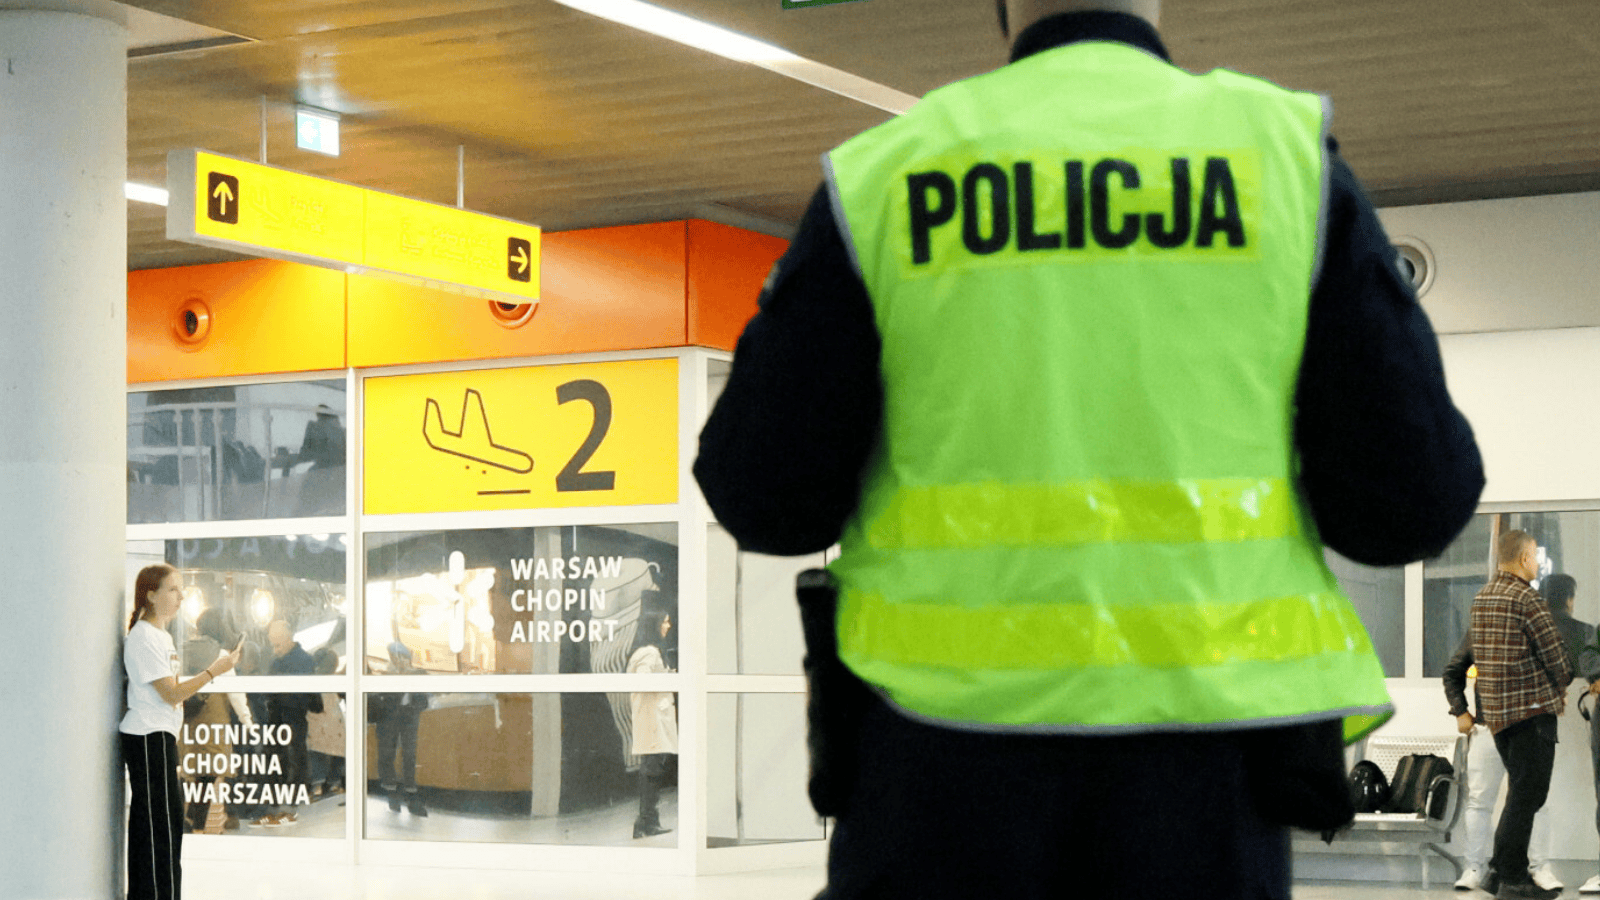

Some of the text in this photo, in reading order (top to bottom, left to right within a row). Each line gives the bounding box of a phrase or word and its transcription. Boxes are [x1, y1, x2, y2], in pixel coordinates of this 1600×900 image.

[907, 157, 1247, 265] POLICJA
[555, 379, 616, 492] 2
[510, 555, 623, 581] WARSAW
[510, 588, 606, 612] CHOPIN
[509, 619, 619, 643] AIRPORT
[183, 723, 293, 746] LOTNISKO
[182, 752, 283, 775] CHOPINA
[182, 782, 311, 805] WARSZAWA
